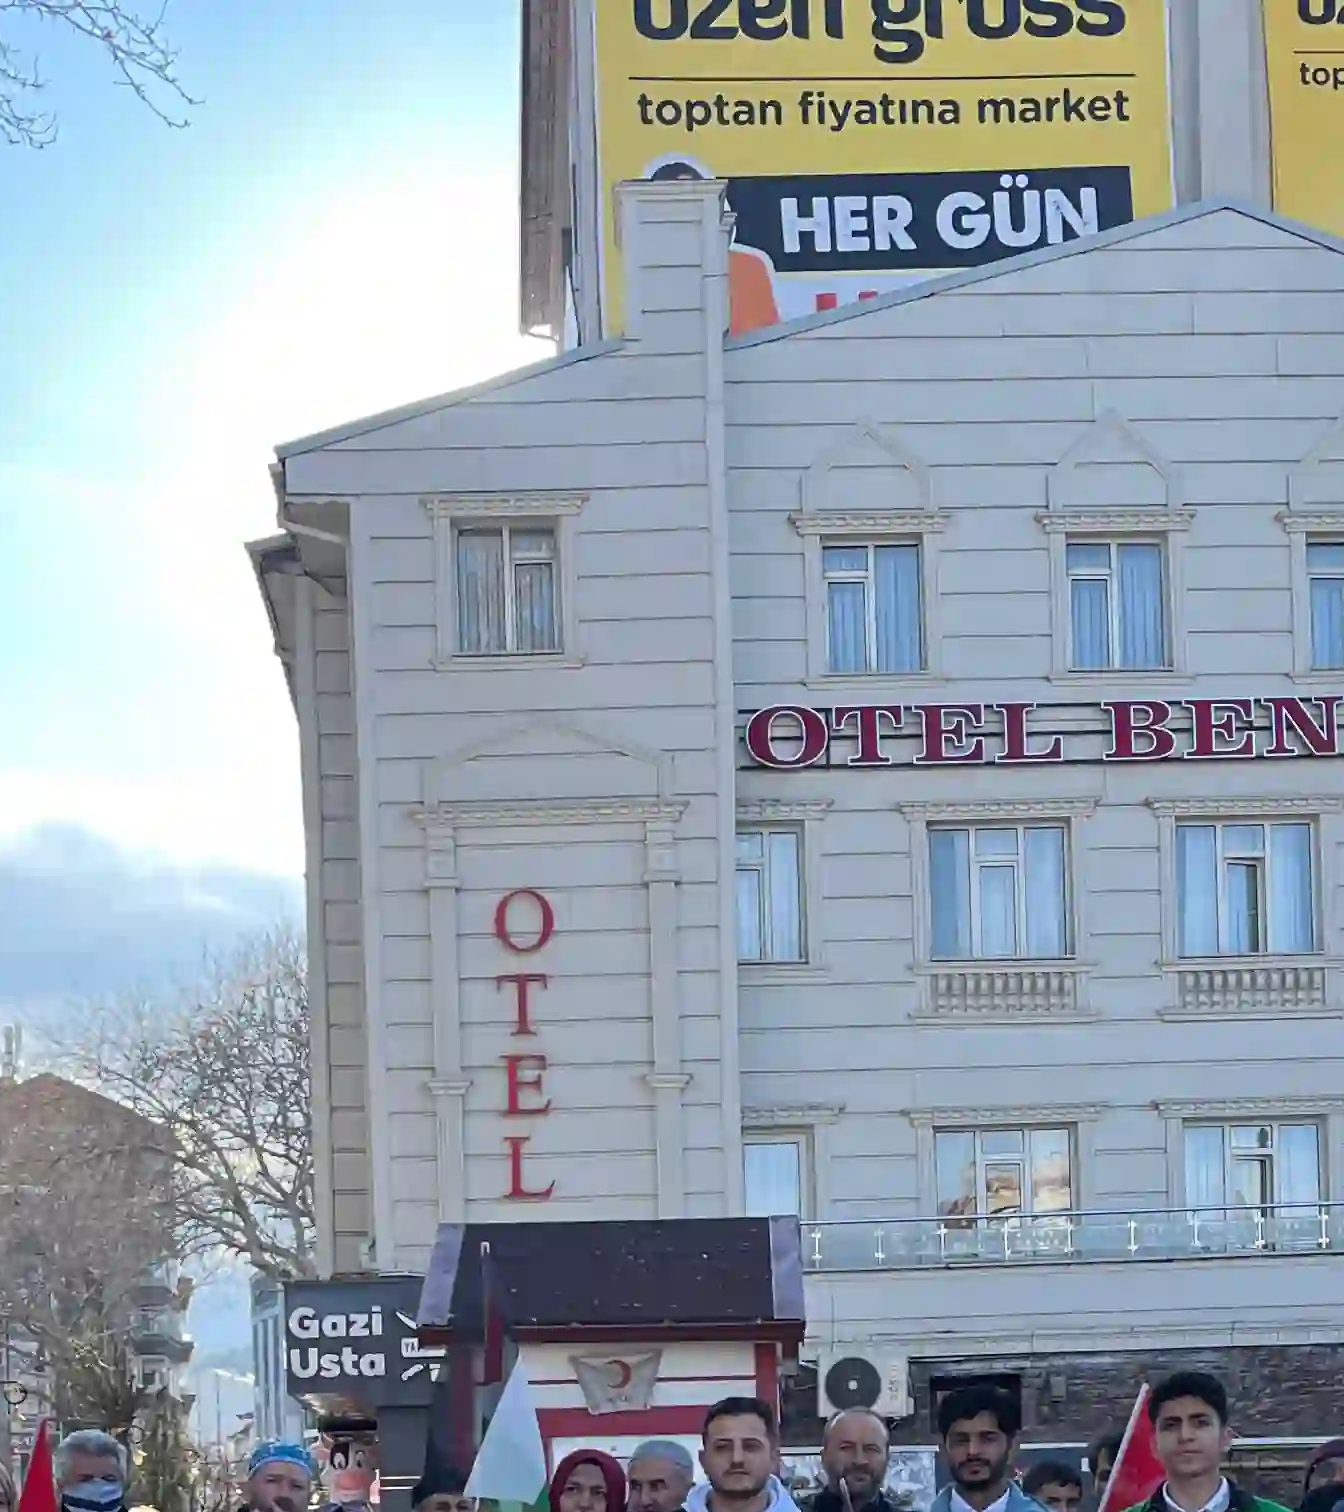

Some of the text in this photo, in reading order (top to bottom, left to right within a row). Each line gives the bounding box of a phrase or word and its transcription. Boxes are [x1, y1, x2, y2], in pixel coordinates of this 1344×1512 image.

[638, 88, 1131, 132] toptan fiyatına market
[779, 174, 1099, 254] HER GÜN
[745, 700, 1063, 768] OTEL
[493, 888, 555, 1201] OTEL
[288, 1305, 383, 1339] Gazi
[290, 1347, 386, 1378] Usta
